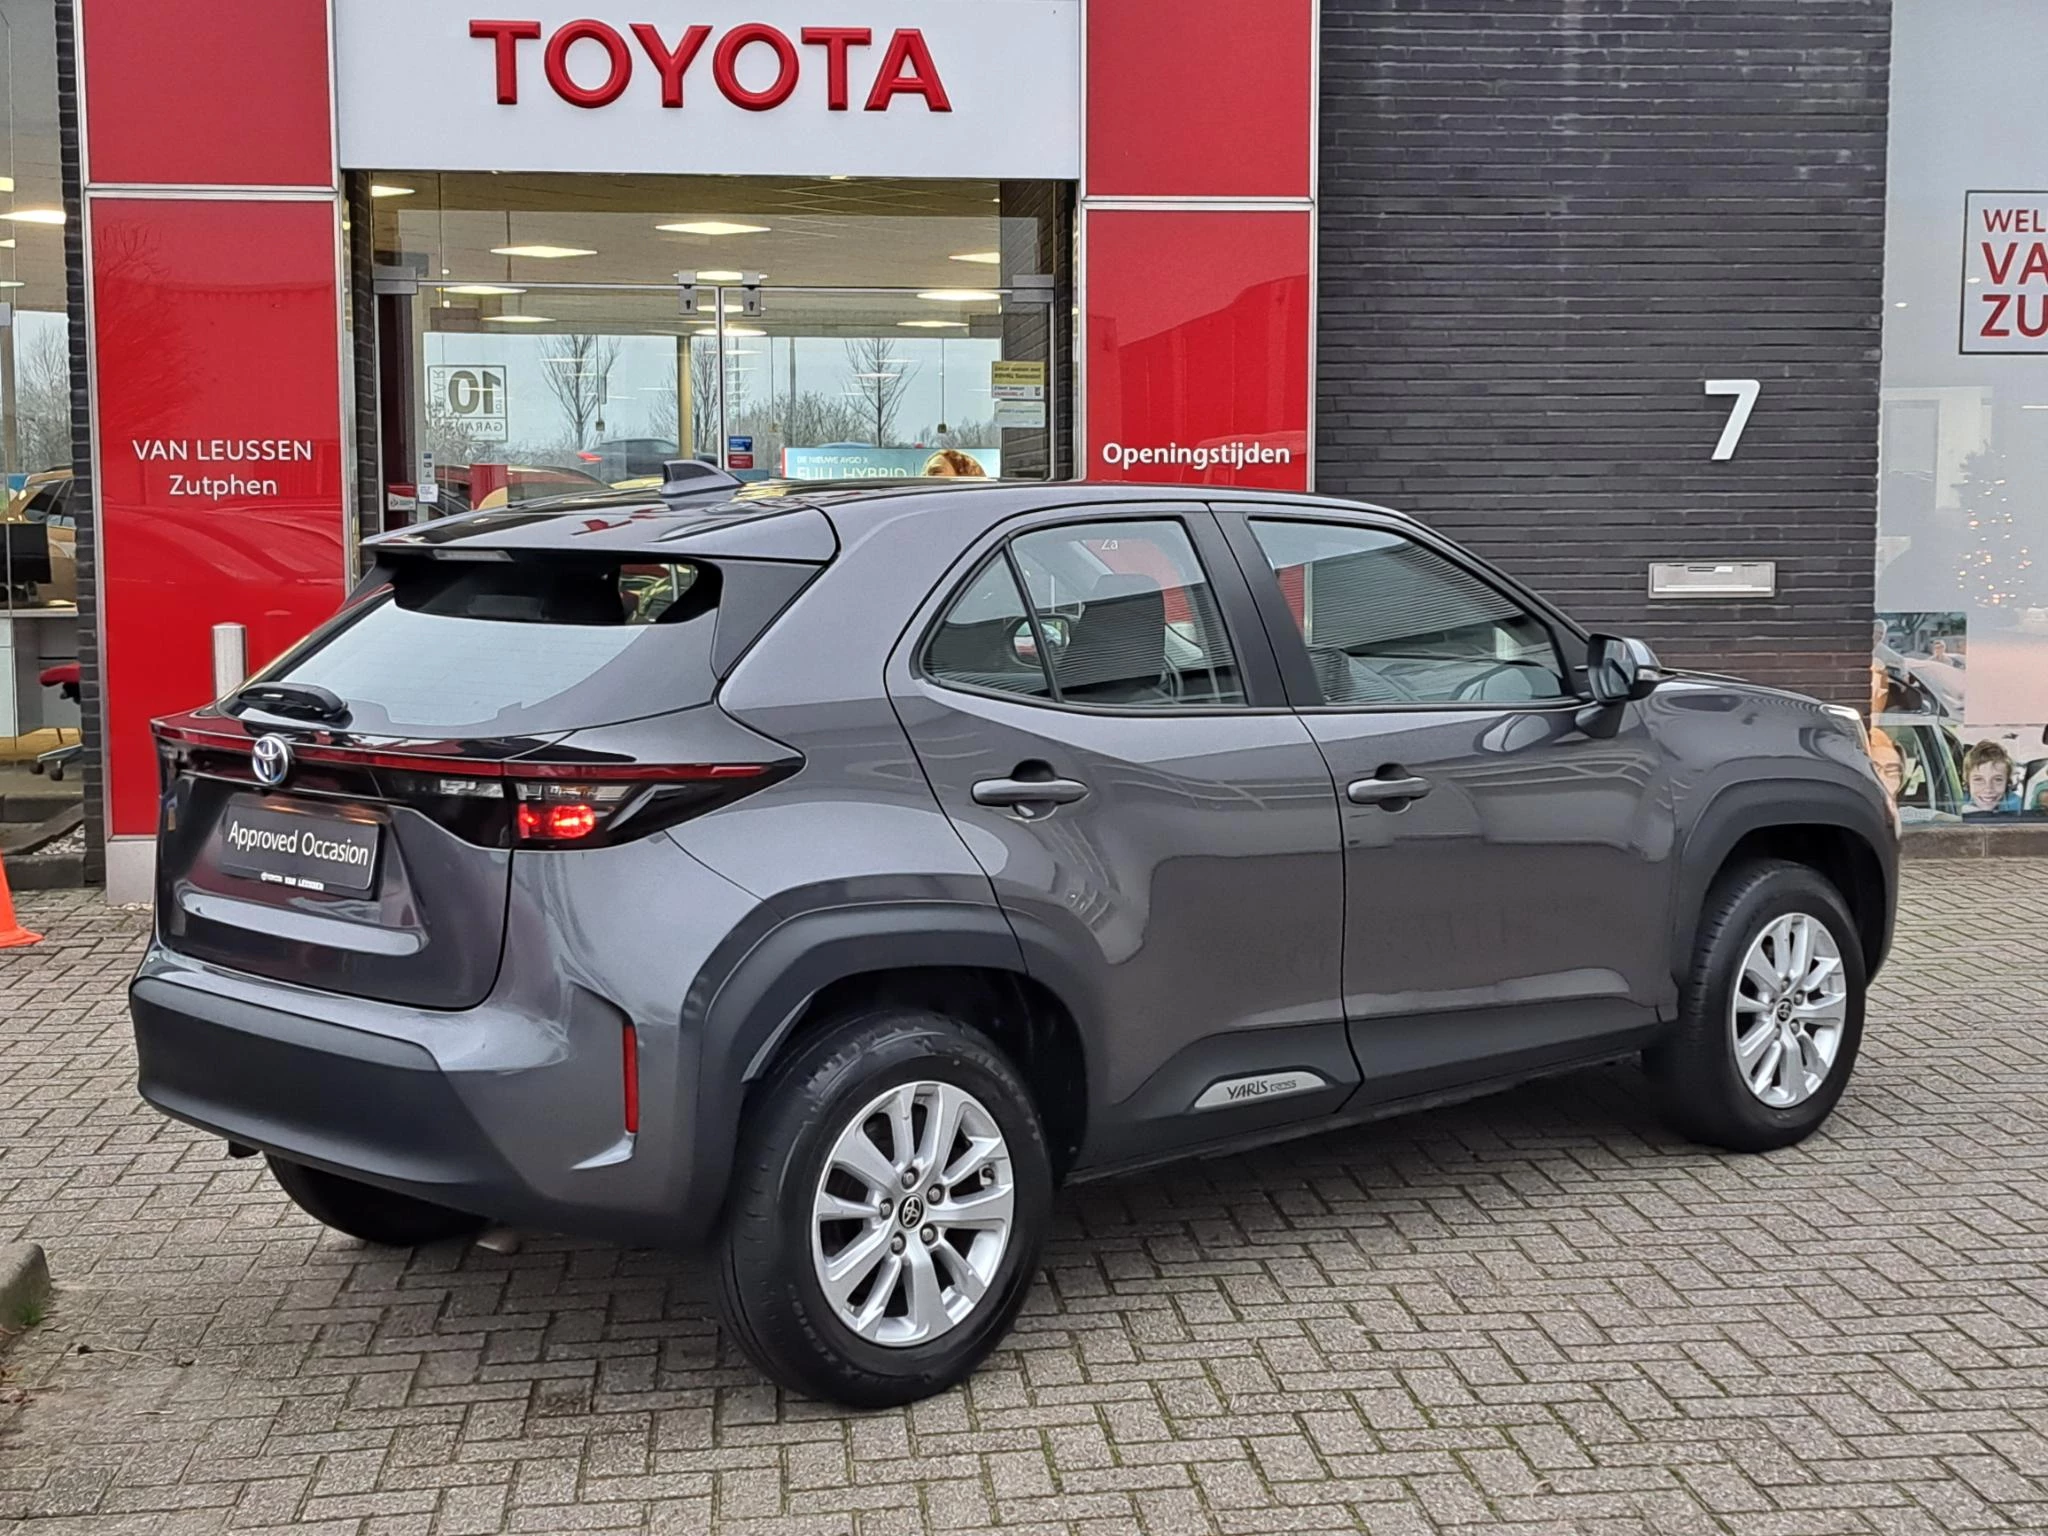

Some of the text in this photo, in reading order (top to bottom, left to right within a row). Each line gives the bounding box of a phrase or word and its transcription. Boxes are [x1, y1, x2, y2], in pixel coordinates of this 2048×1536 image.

[469, 18, 953, 112] TOYOTA
[1981, 241, 2048, 285] VA
[1704, 379, 1762, 461] 7
[132, 439, 312, 461] VAN LEUSSEN
[1102, 441, 1291, 470] Openingstijden
[169, 473, 277, 500] Zutphen
[227, 820, 369, 866] Approved Occasion
[1226, 1080, 1268, 1099] YARIS
